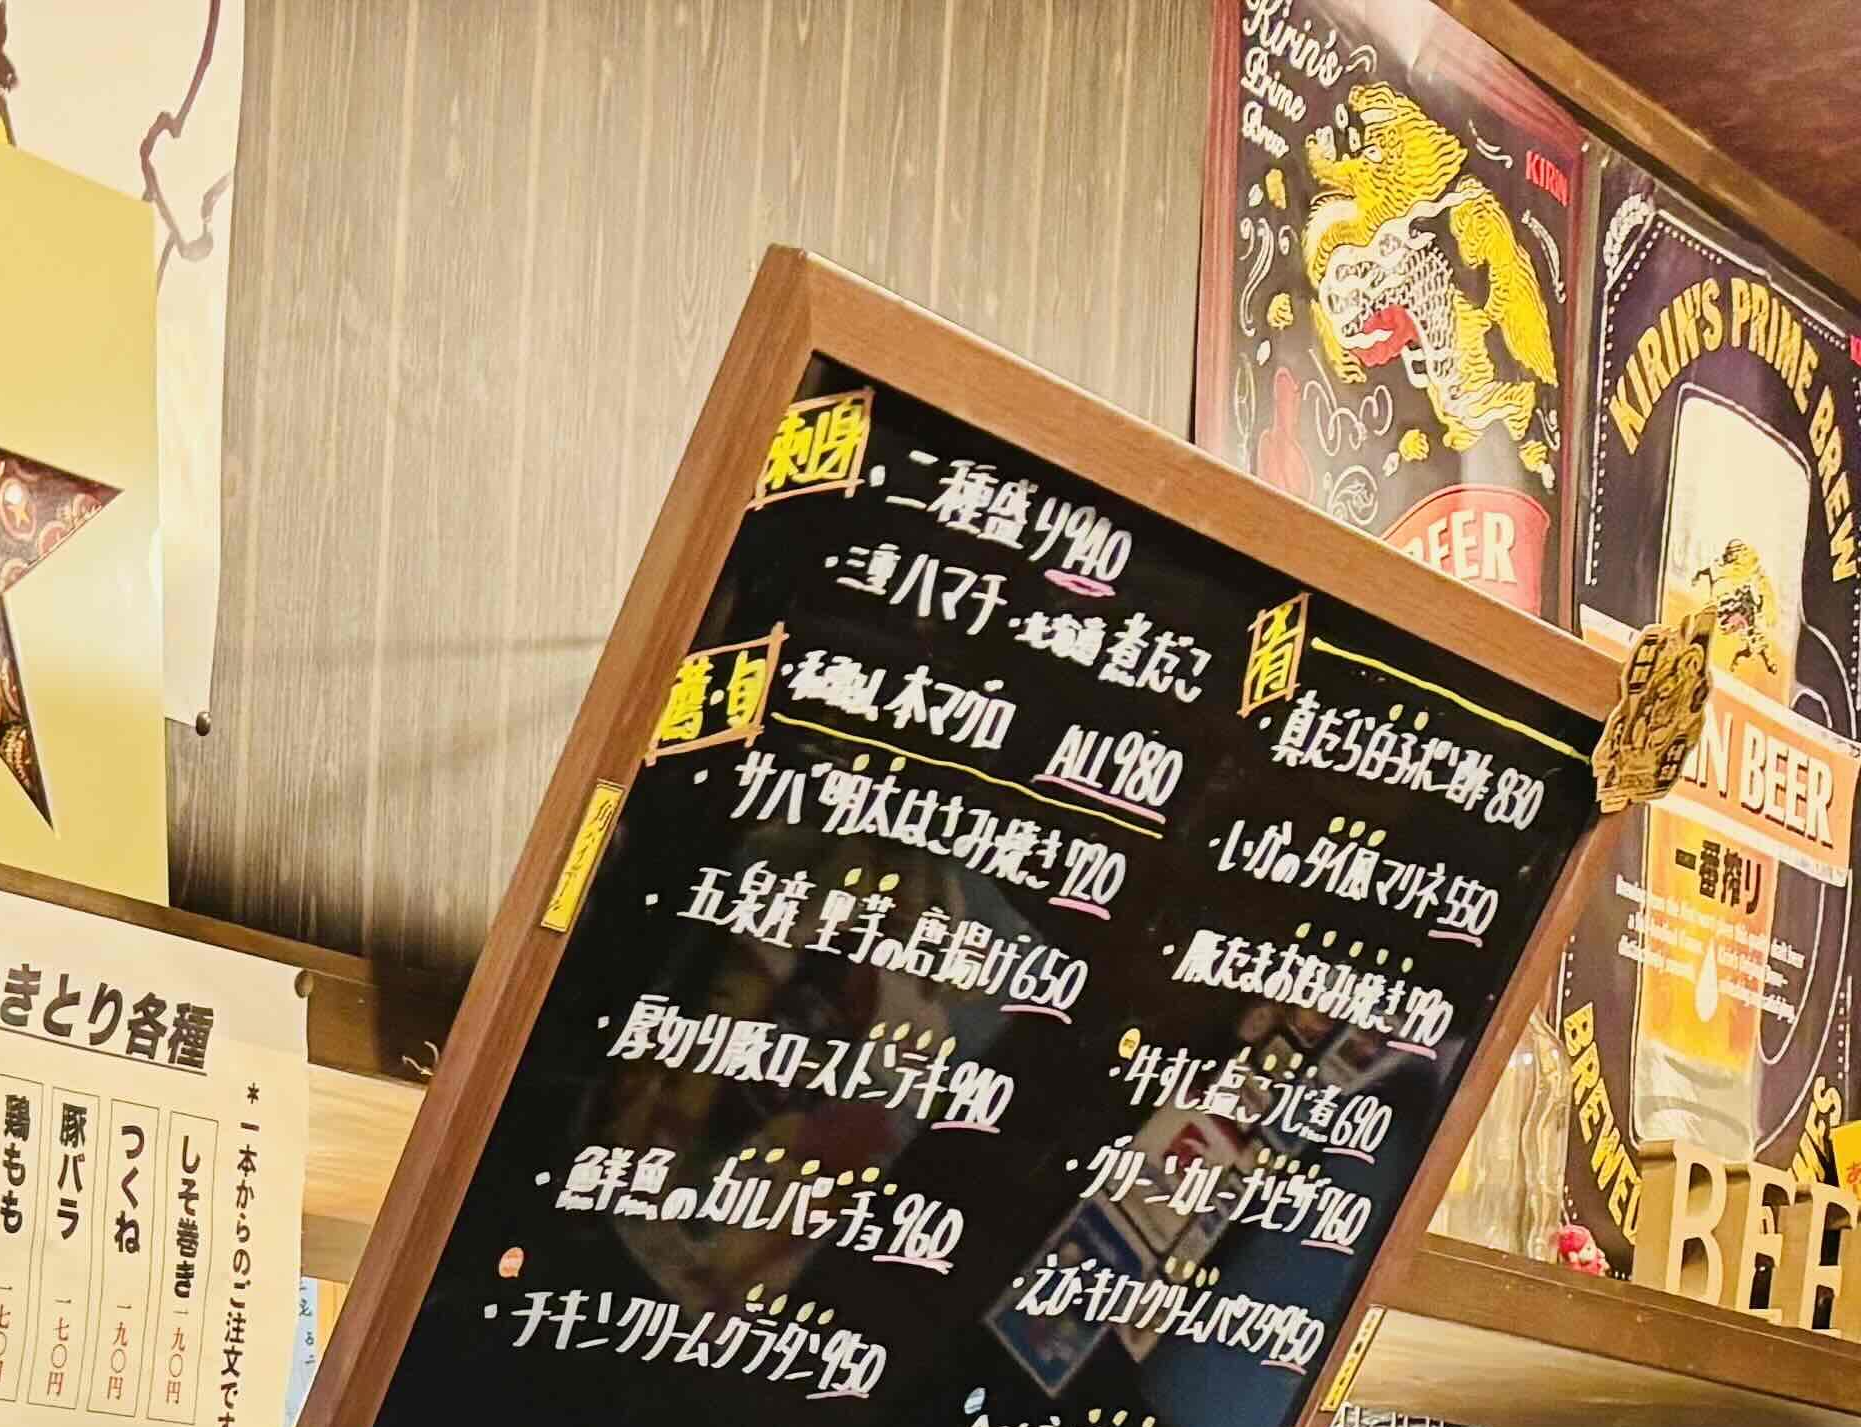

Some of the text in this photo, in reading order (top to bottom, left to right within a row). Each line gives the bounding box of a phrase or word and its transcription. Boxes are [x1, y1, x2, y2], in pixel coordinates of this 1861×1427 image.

[1525, 150, 1570, 206] KIRIN
[766, 397, 866, 491] 刺身
[1609, 276, 1857, 583] KIRIN'S PRIME BREW
[836, 543, 1008, 636] 三重ハマチ
[1044, 723, 1184, 809] ALL 980
[1483, 766, 1546, 831] 830
[1739, 722, 1836, 852] BEER
[1673, 838, 1765, 916] 一番搾り
[1010, 945, 1089, 1011] 650
[1331, 1094, 1394, 1154] 690
[57, 1102, 88, 1240] 豚バラ
[113, 1124, 146, 1255] つくね
[555, 1145, 965, 1262] 鮮魚のカルパッチョ 960
[173, 1134, 202, 1300] しそ巻き
[1309, 1189, 1374, 1248] 760
[816, 1329, 888, 1394] 950
[1272, 1306, 1326, 1368] 950
